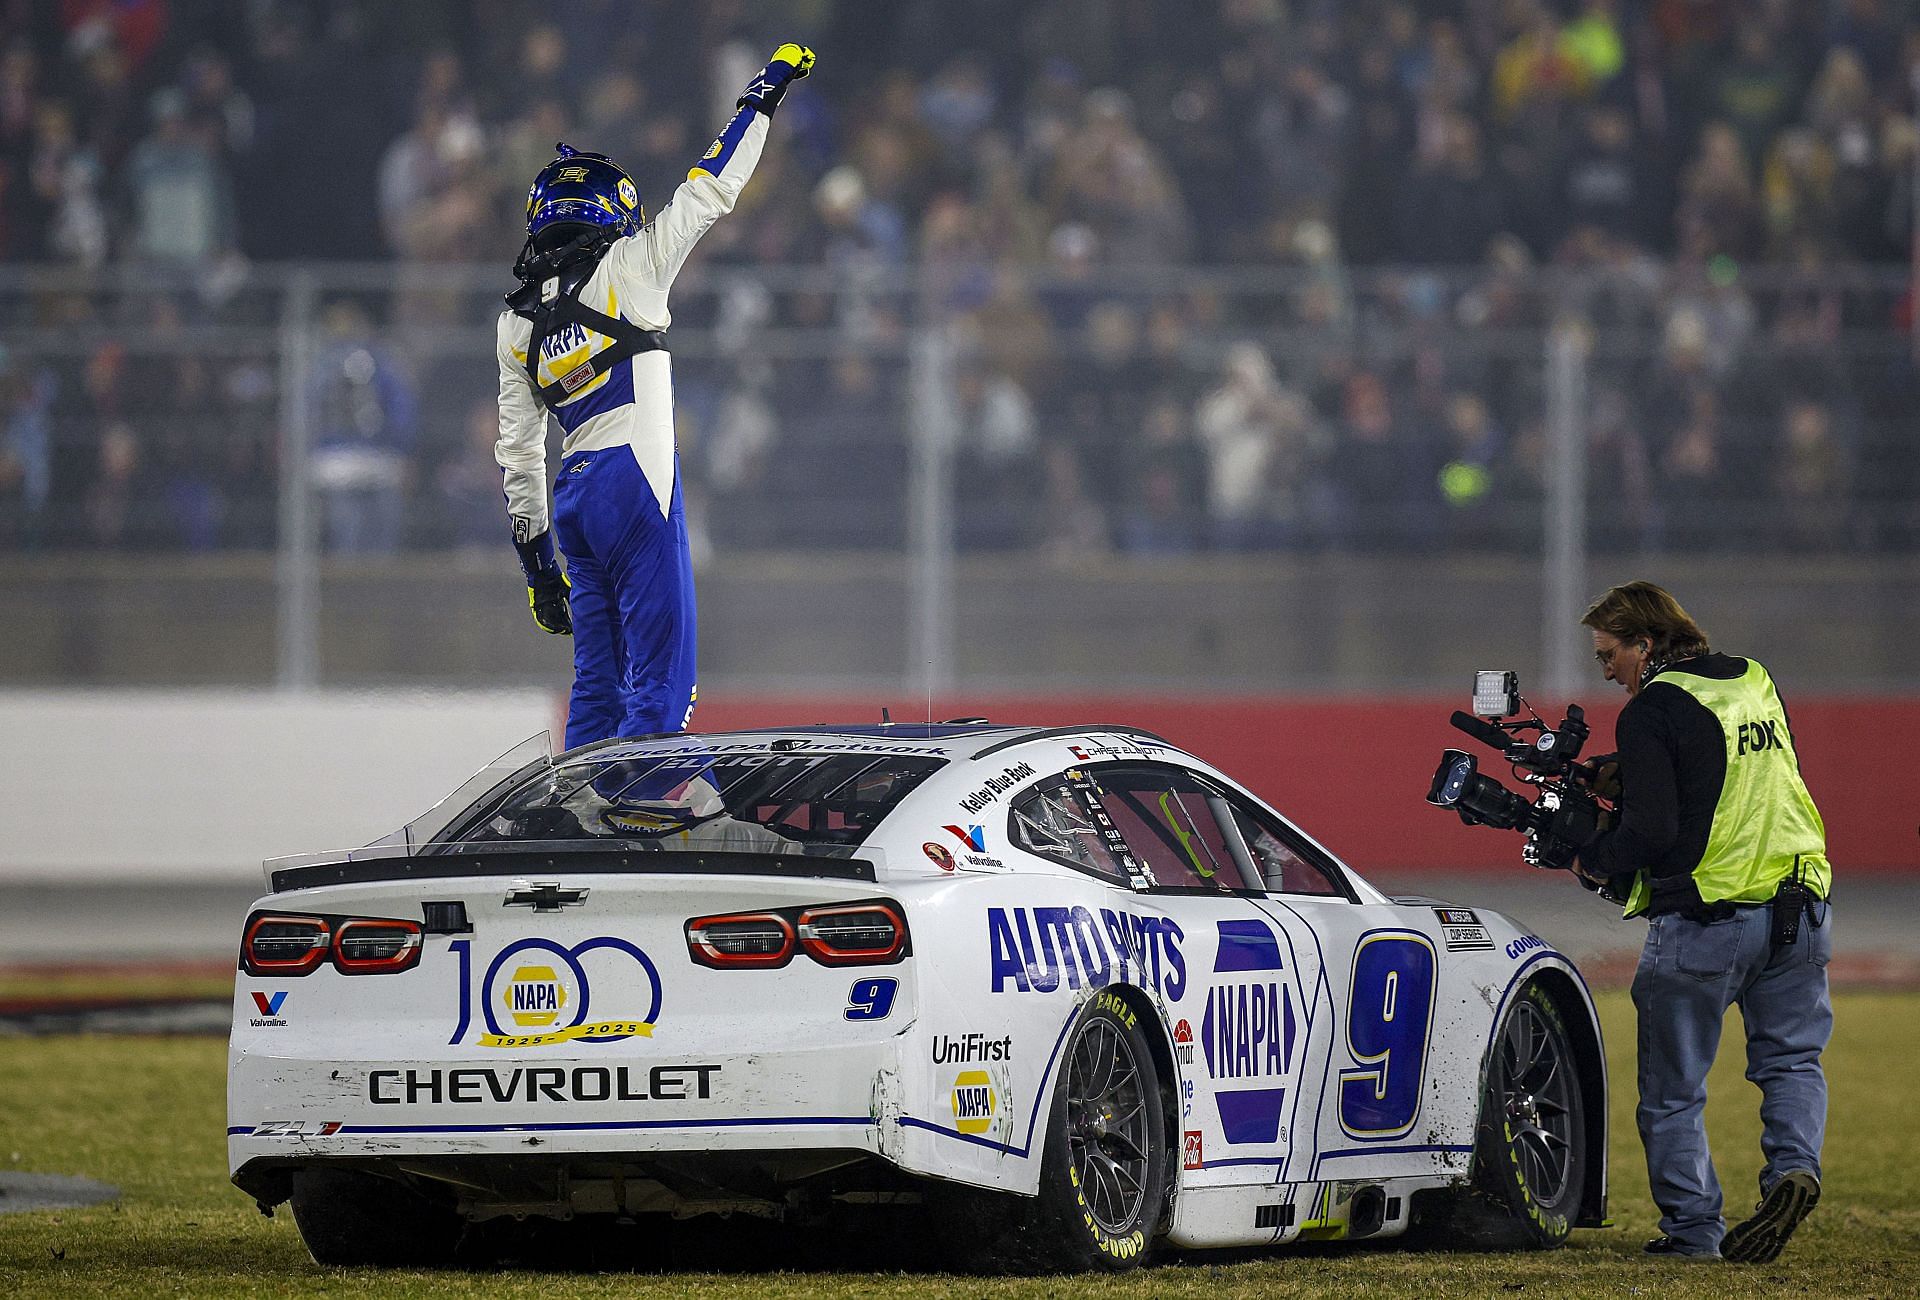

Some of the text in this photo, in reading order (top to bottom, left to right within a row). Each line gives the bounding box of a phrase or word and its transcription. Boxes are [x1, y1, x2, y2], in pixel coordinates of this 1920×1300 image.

[541, 276, 559, 303] 9
[542, 322, 587, 360] NAPA
[565, 367, 592, 388] SIMPSON
[1086, 747, 1165, 755] CHASE ELLIOTT
[1738, 720, 1783, 755] FOX
[959, 761, 1037, 815] Kelley Blue Book
[965, 855, 1004, 868] Valvoline
[1448, 911, 1474, 923] NASCAR
[1450, 928, 1483, 940] CUP SERIES
[988, 905, 1187, 1002] AUTO PARTS
[448, 937, 662, 1044] 100
[514, 984, 556, 1010] NAPA
[844, 976, 899, 1021] 9
[249, 1018, 288, 1027] Valvoline
[1097, 993, 1137, 1030] EAGLE
[585, 1024, 637, 1035] 2025
[1218, 983, 1281, 1078] NAPA
[1338, 928, 1438, 1141] 9
[932, 1034, 1011, 1064] UniFirst
[369, 1065, 721, 1104] CHEVROLET
[957, 1087, 990, 1117] NAPA
[252, 1121, 342, 1136] ZL1
